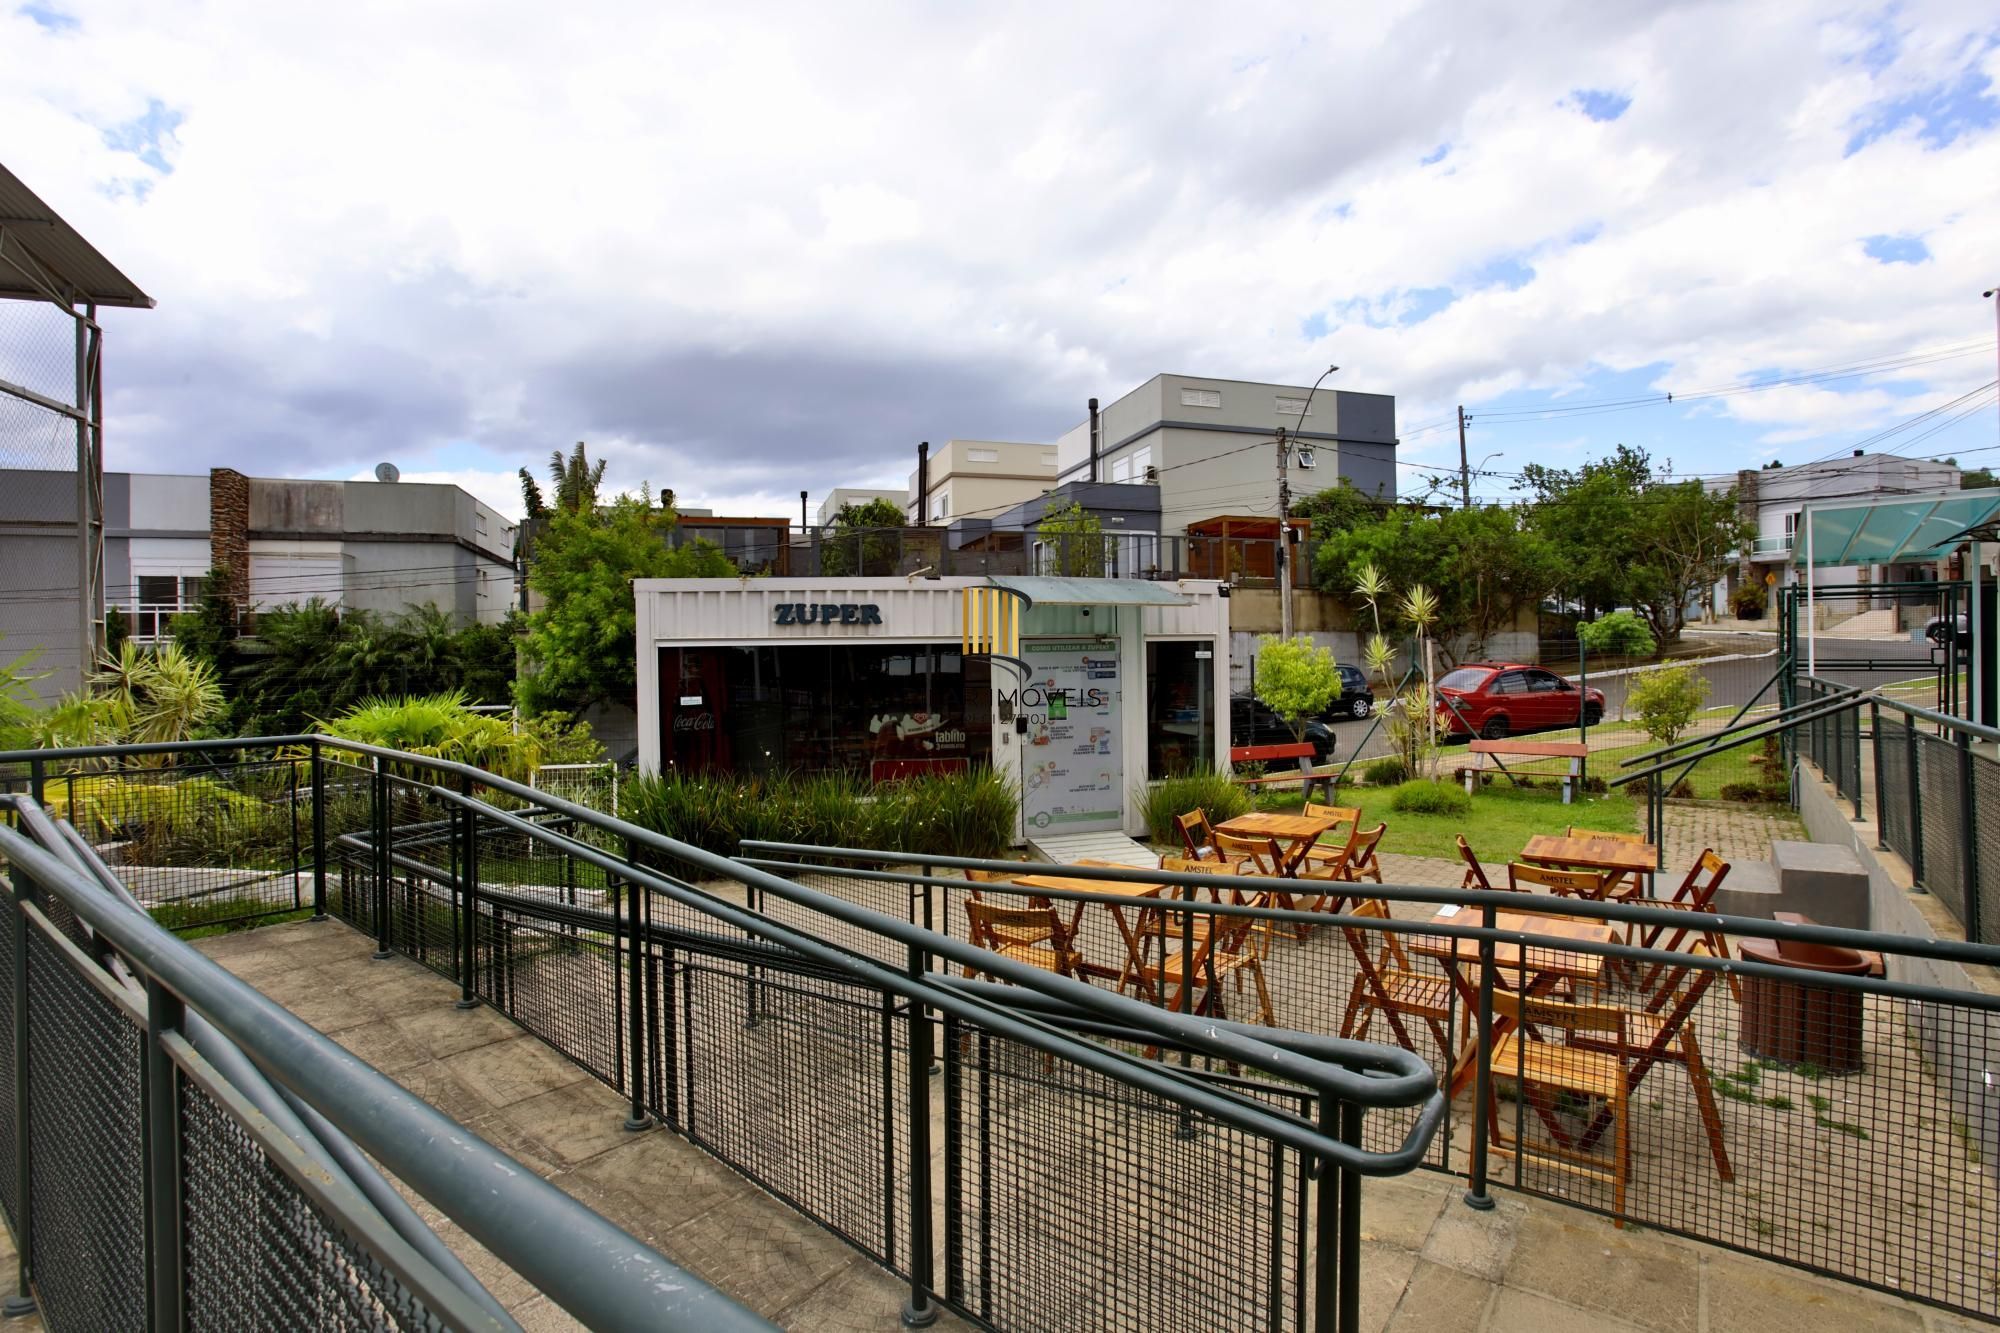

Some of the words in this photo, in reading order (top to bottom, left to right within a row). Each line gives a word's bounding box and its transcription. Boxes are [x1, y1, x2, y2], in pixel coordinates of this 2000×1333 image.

[775, 603, 882, 625] ZUPER
[1322, 810, 1343, 818] AMSTEL
[1231, 842, 1253, 851] AMSTEL
[1184, 865, 1213, 875] AMSTEL
[1539, 874, 1575, 885] AMSTEL
